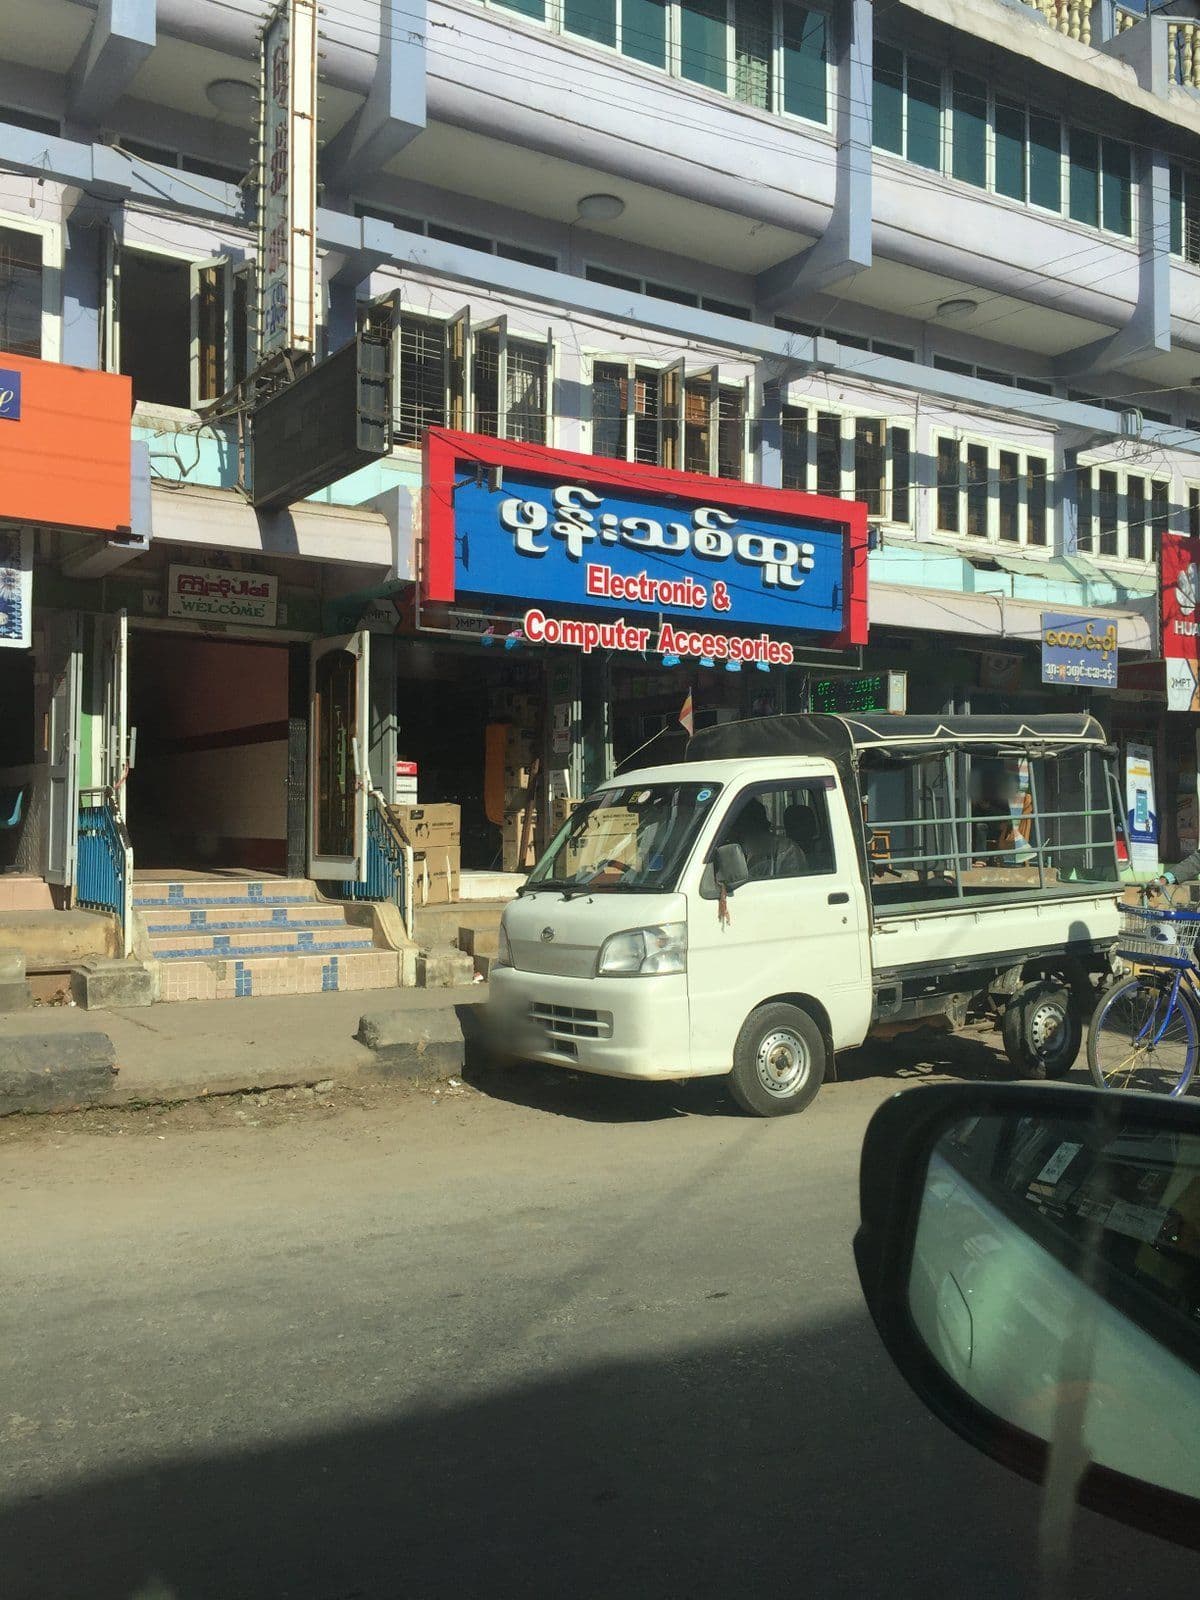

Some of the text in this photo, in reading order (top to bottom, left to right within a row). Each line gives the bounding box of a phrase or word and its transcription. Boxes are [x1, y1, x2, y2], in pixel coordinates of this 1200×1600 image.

[587, 563, 732, 611] Electronic &
[180, 600, 265, 618] WELCOME
[524, 609, 794, 665] Computer Accessories
[1175, 678, 1191, 688] MPT
